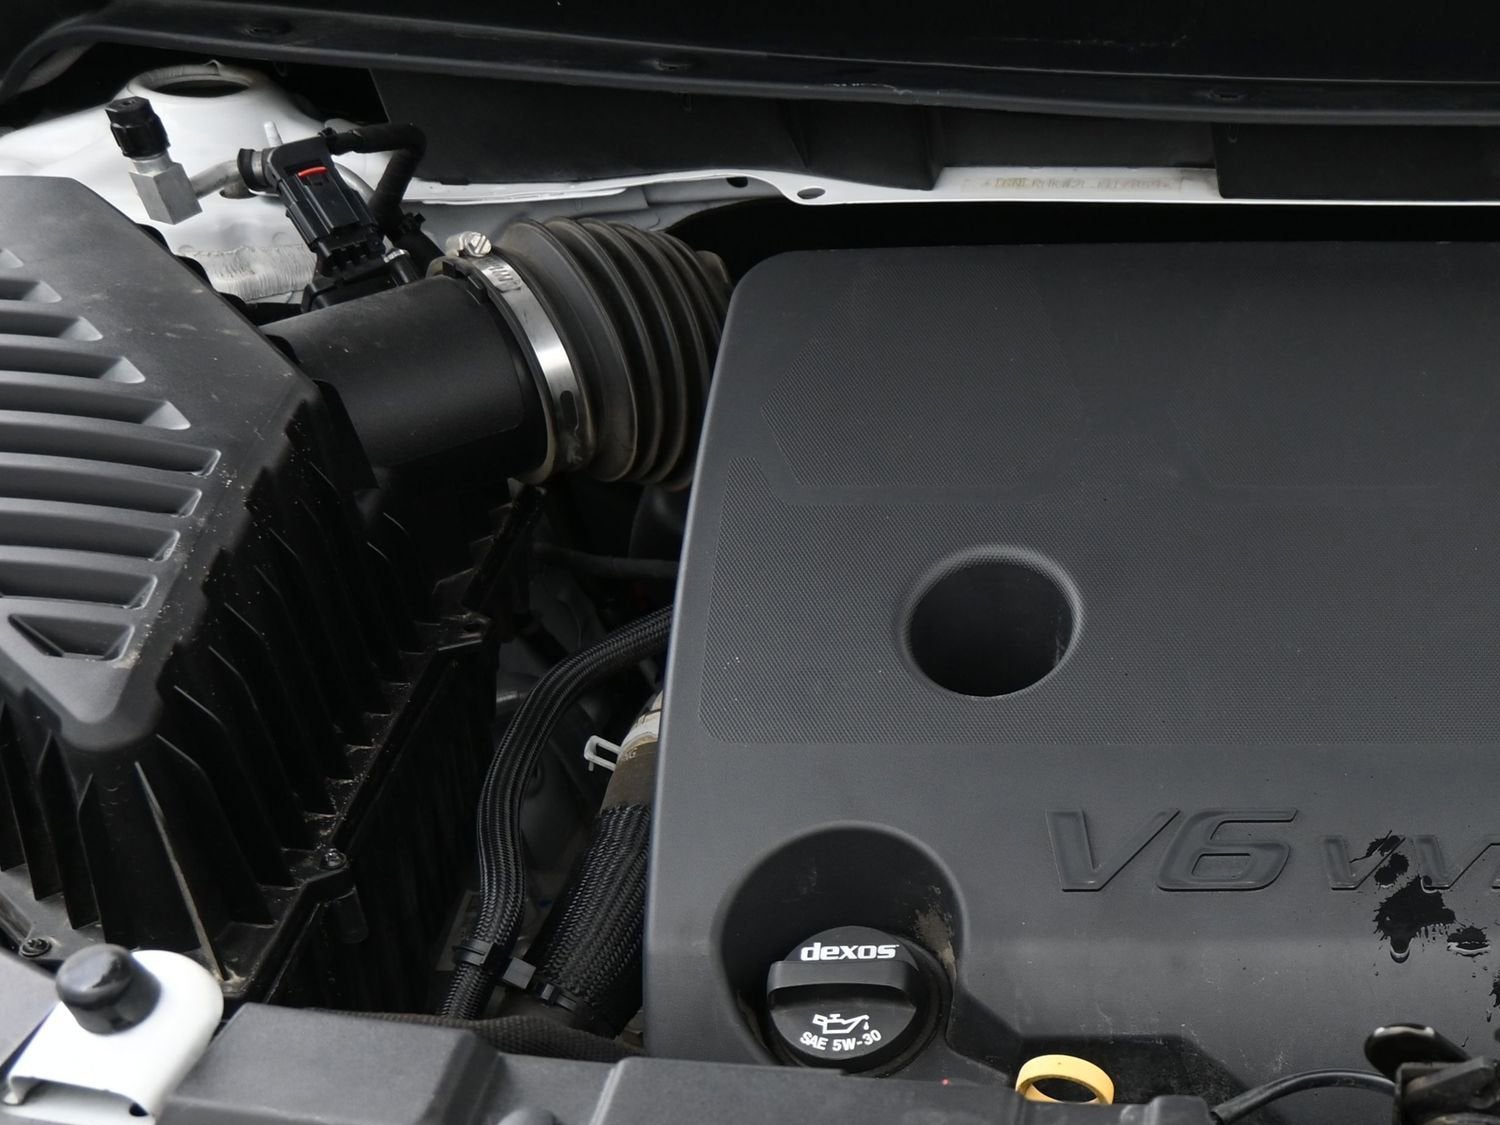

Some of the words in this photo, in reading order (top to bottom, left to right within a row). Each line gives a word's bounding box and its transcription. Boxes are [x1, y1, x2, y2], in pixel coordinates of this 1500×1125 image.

[1045, 807, 1298, 892] V6
[800, 942, 899, 961] dexos
[800, 1031, 829, 1051] SAE
[832, 1029, 882, 1052] 5W-30
